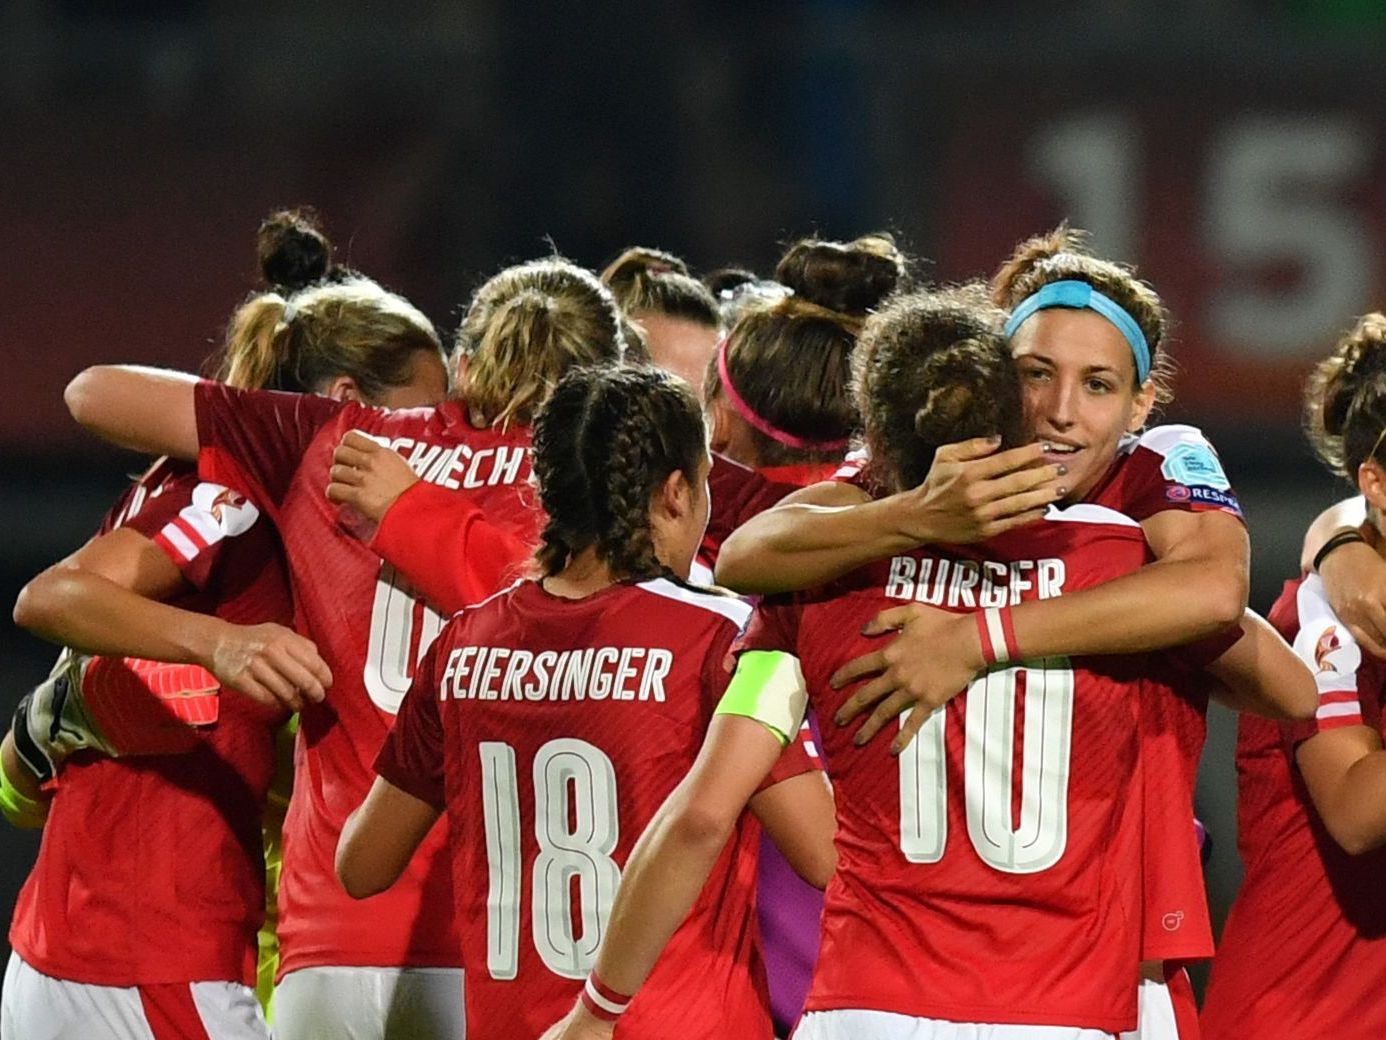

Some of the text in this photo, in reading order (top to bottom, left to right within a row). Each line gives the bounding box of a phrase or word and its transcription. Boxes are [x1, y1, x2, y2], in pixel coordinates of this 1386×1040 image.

[1026, 108, 1386, 362] 15
[440, 646, 673, 702] FEIERSINGER
[898, 656, 1075, 875] 10
[478, 737, 624, 980] 18
